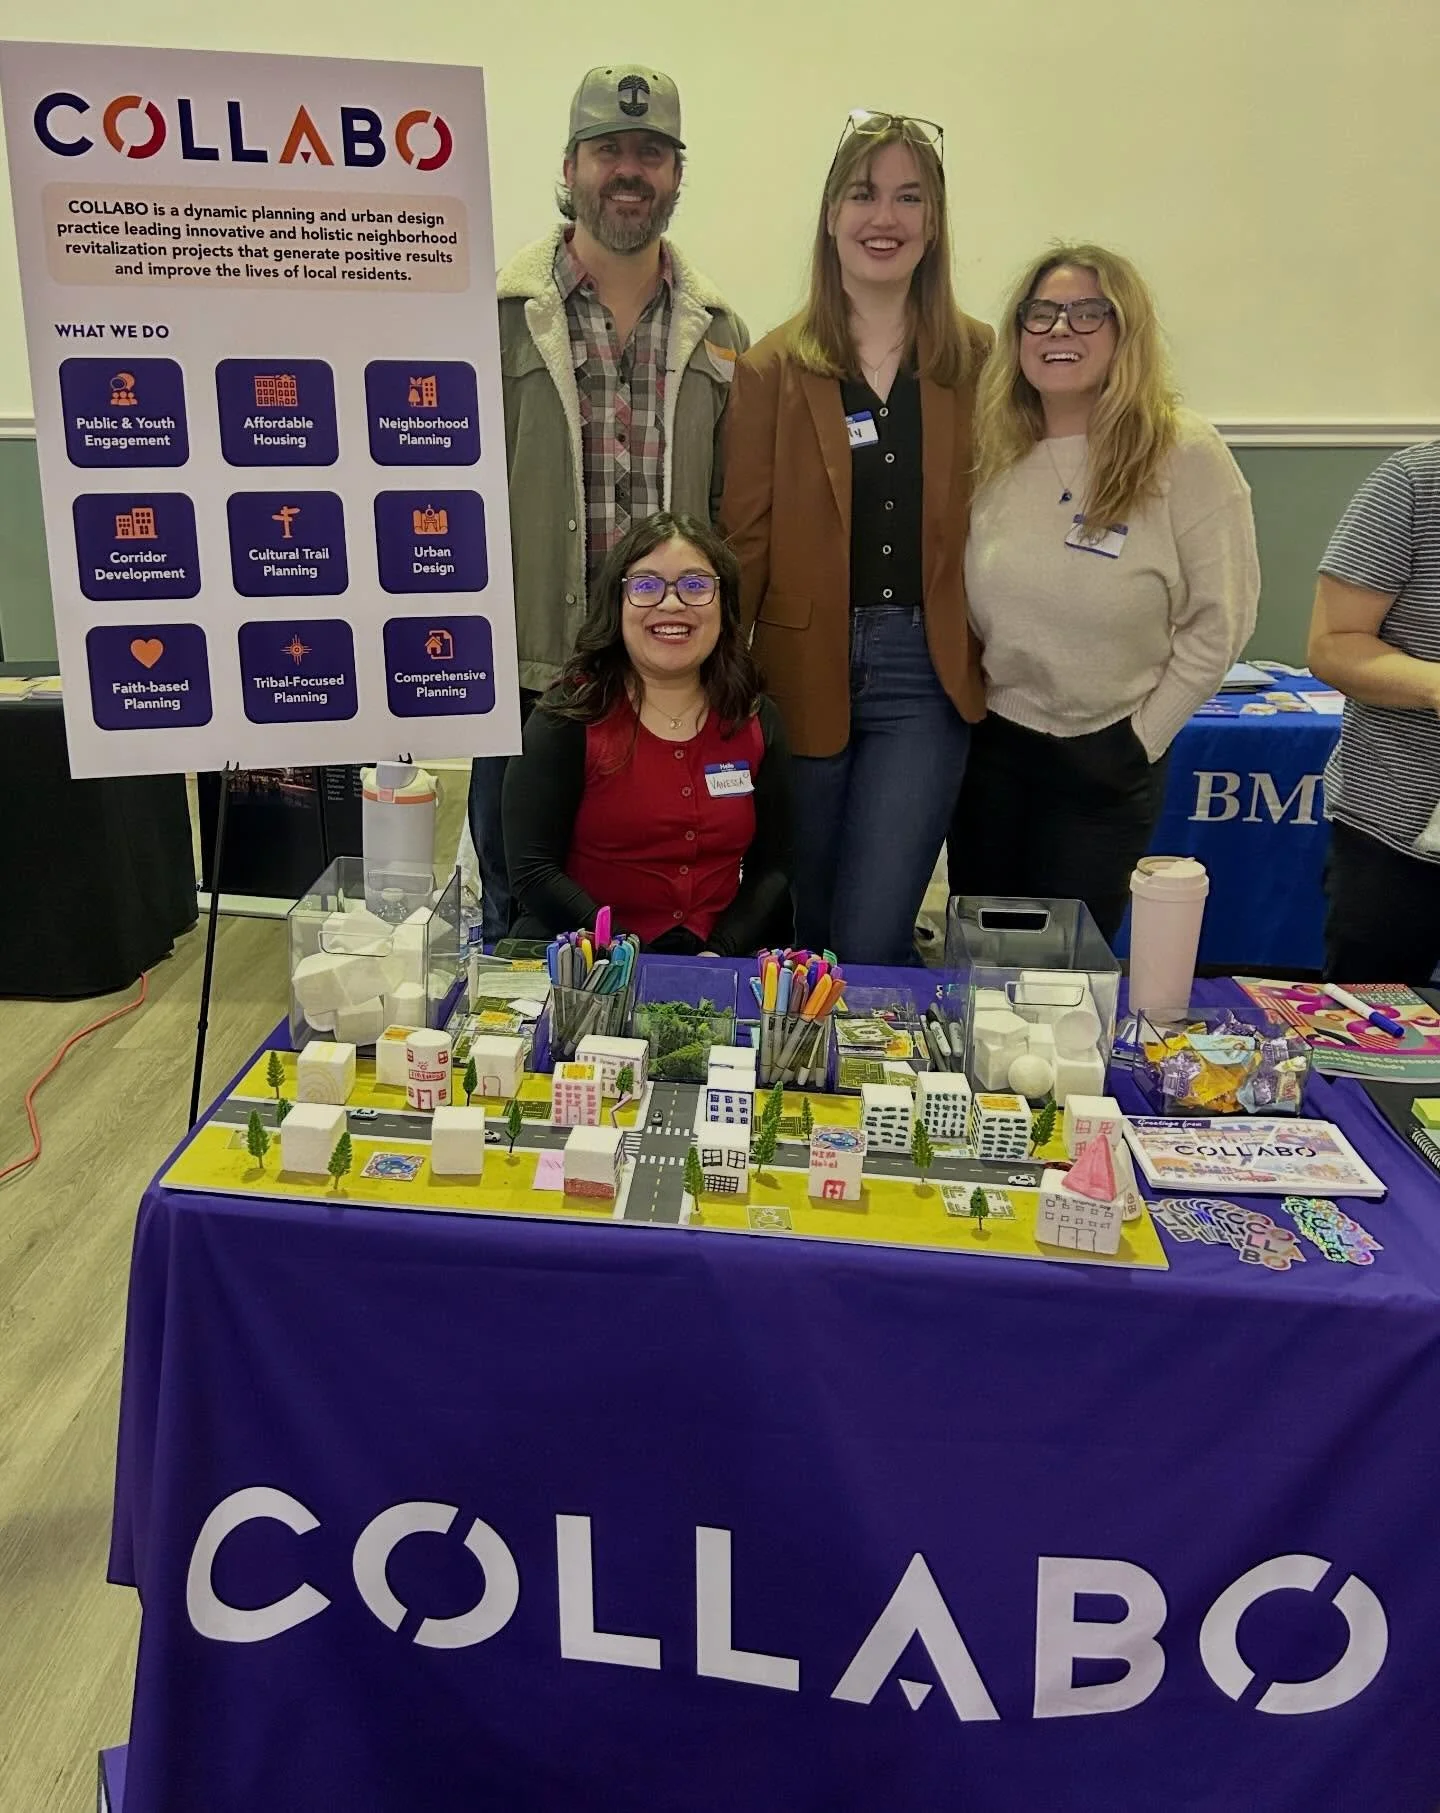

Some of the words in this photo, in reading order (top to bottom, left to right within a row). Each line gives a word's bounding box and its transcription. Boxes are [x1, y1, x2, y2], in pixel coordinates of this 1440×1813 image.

[33, 91, 454, 172] COLLABO
[68, 200, 148, 215] COLLABO
[153, 202, 165, 215] is
[170, 206, 179, 216] a
[183, 203, 247, 220] dynamic
[251, 205, 314, 224] planning
[319, 208, 346, 221] and
[351, 208, 392, 223] urban
[397, 210, 444, 228] design
[56, 220, 119, 237] practice
[124, 220, 181, 239] leading
[186, 224, 264, 238] innovative
[269, 225, 296, 239] and
[300, 226, 353, 241] holistic
[357, 228, 457, 245] neighborhood
[65, 241, 168, 256] revitalization
[172, 243, 233, 260] projects
[237, 244, 269, 258] that
[273, 248, 339, 262] generate
[344, 247, 401, 263] positive
[406, 249, 452, 263] results
[114, 261, 143, 274] and
[148, 265, 211, 279] improve
[215, 263, 240, 276] the
[245, 263, 279, 277] lives
[283, 264, 299, 277] of
[303, 264, 336, 278] local
[341, 266, 412, 281] residents.
[54, 324, 105, 337] WHAT
[109, 324, 137, 337] WE
[142, 324, 169, 338] DO
[76, 416, 118, 429] Public
[121, 417, 132, 428] &
[135, 416, 175, 428] Youth
[243, 416, 313, 428] Affordable
[378, 416, 468, 431] Neighborhood
[85, 434, 170, 450] Engagement
[253, 433, 306, 448] Housing
[398, 432, 451, 448] Planning
[109, 550, 167, 563] Corridor
[248, 547, 299, 560] Cultural
[301, 547, 329, 559] Trail
[414, 545, 451, 557] Urban
[94, 567, 185, 582] Development
[263, 564, 317, 578] Planning
[412, 561, 454, 575] Design
[253, 673, 344, 688] Tribal-Focused
[394, 669, 486, 684] Comprehensive
[112, 679, 189, 693] Faith-based
[416, 685, 466, 698] Planning
[124, 696, 180, 710] Planning
[274, 691, 327, 704] Planning
[1175, 1144, 1317, 1158] COLLABO
[187, 1487, 1388, 1721] COLLABO
